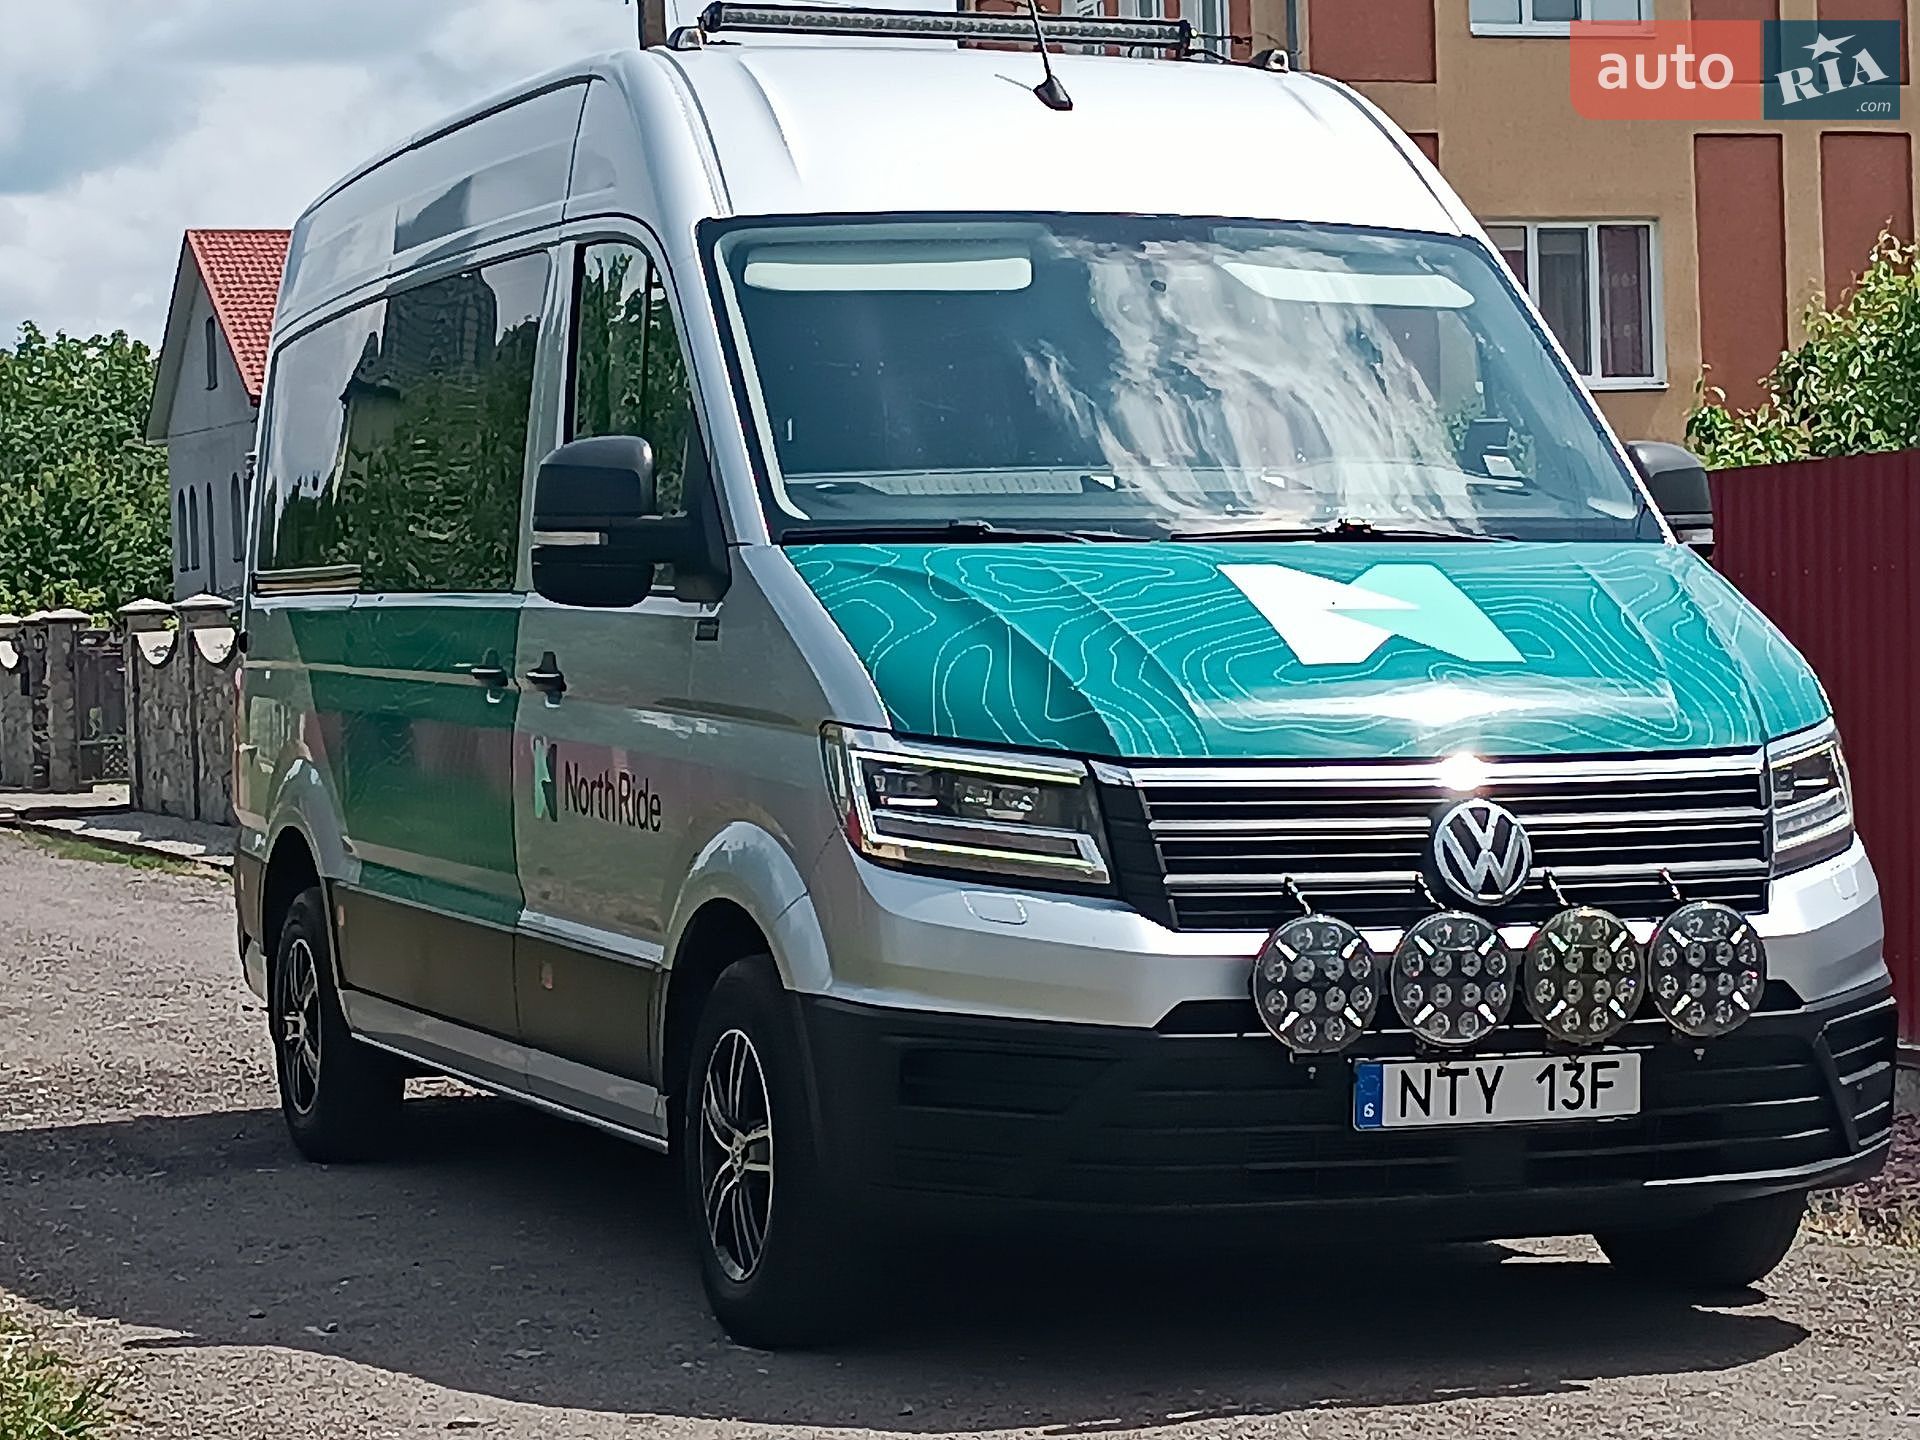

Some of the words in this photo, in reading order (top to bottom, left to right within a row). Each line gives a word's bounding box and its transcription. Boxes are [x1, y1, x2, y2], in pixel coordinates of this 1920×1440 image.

[565, 760, 661, 832] NorthRide
[1440, 804, 1523, 896] VW
[1400, 1065, 1504, 1118] NTY
[1536, 1060, 1620, 1112] 13F
